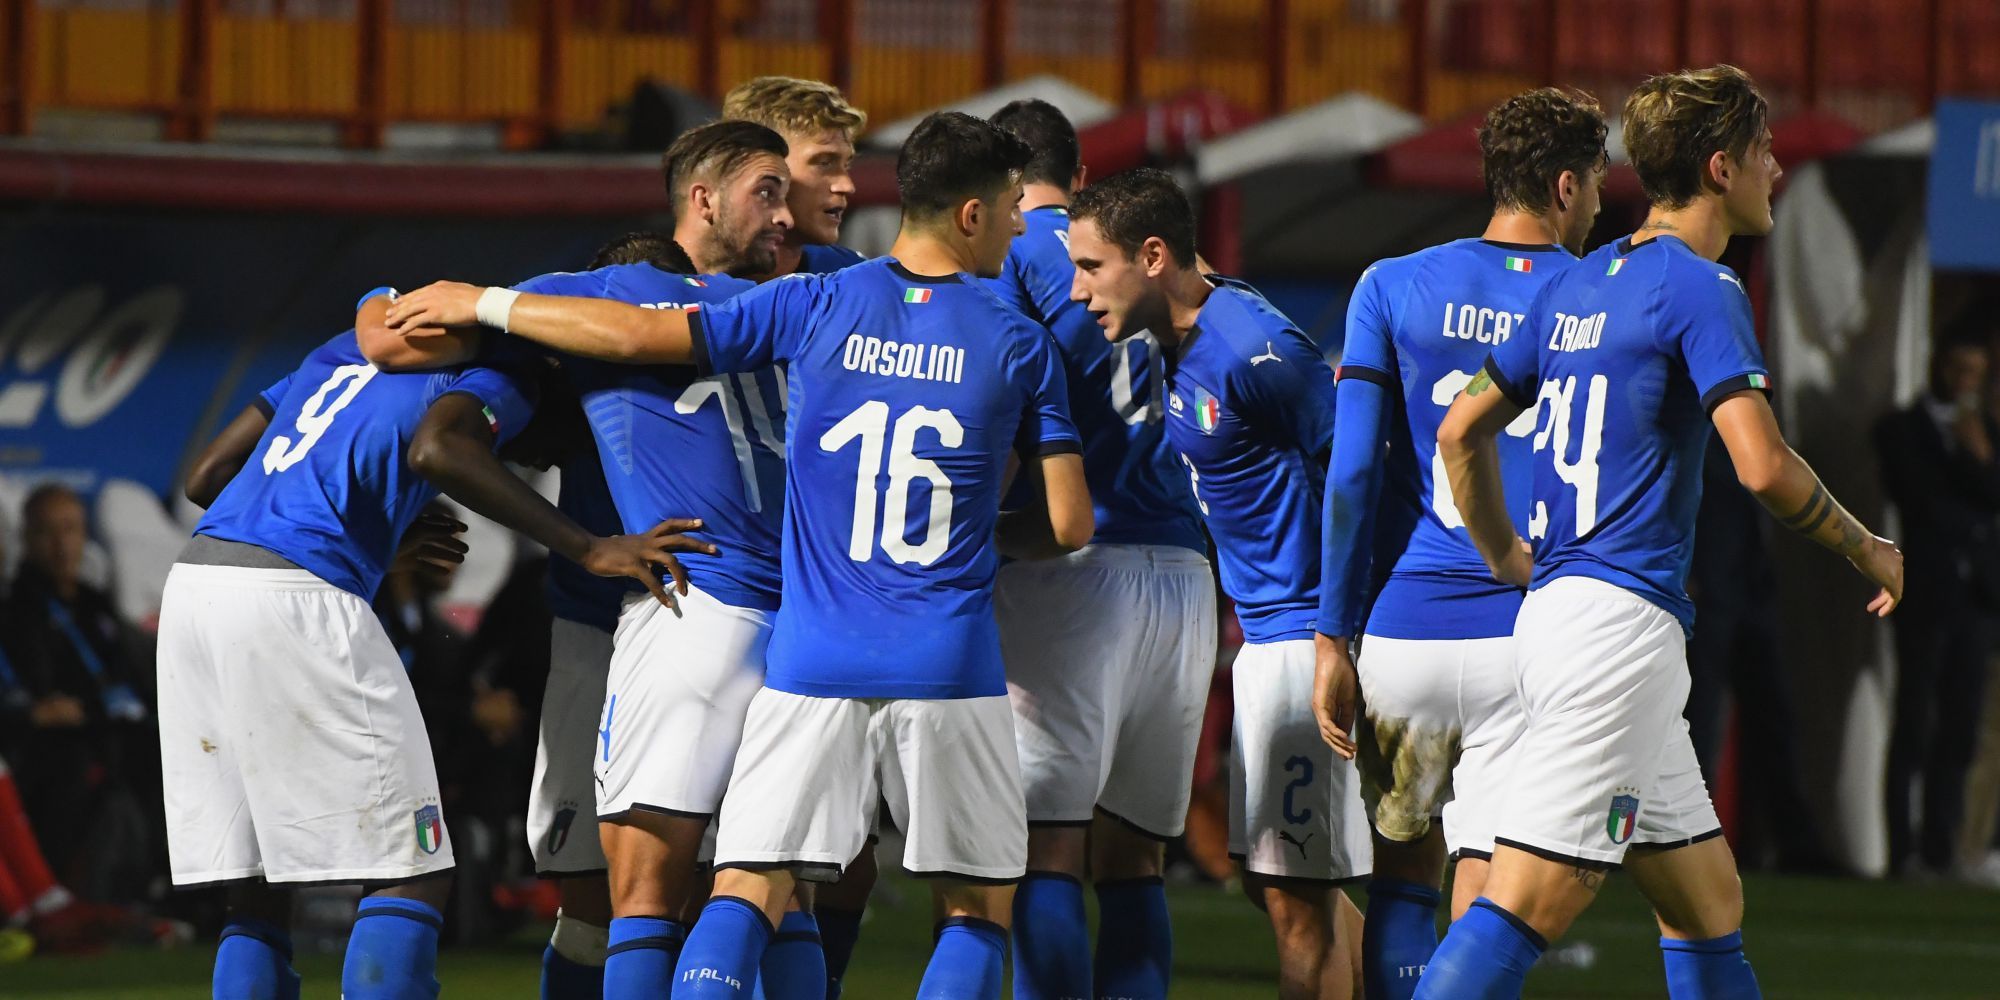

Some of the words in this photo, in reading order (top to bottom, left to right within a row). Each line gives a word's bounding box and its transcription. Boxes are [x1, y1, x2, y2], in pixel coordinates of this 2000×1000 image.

[842, 333, 965, 384] ORSOLINI
[262, 361, 379, 476] 9
[819, 399, 965, 566] 16
[1283, 755, 1314, 825] 2
[682, 967, 741, 991] ITALIA
